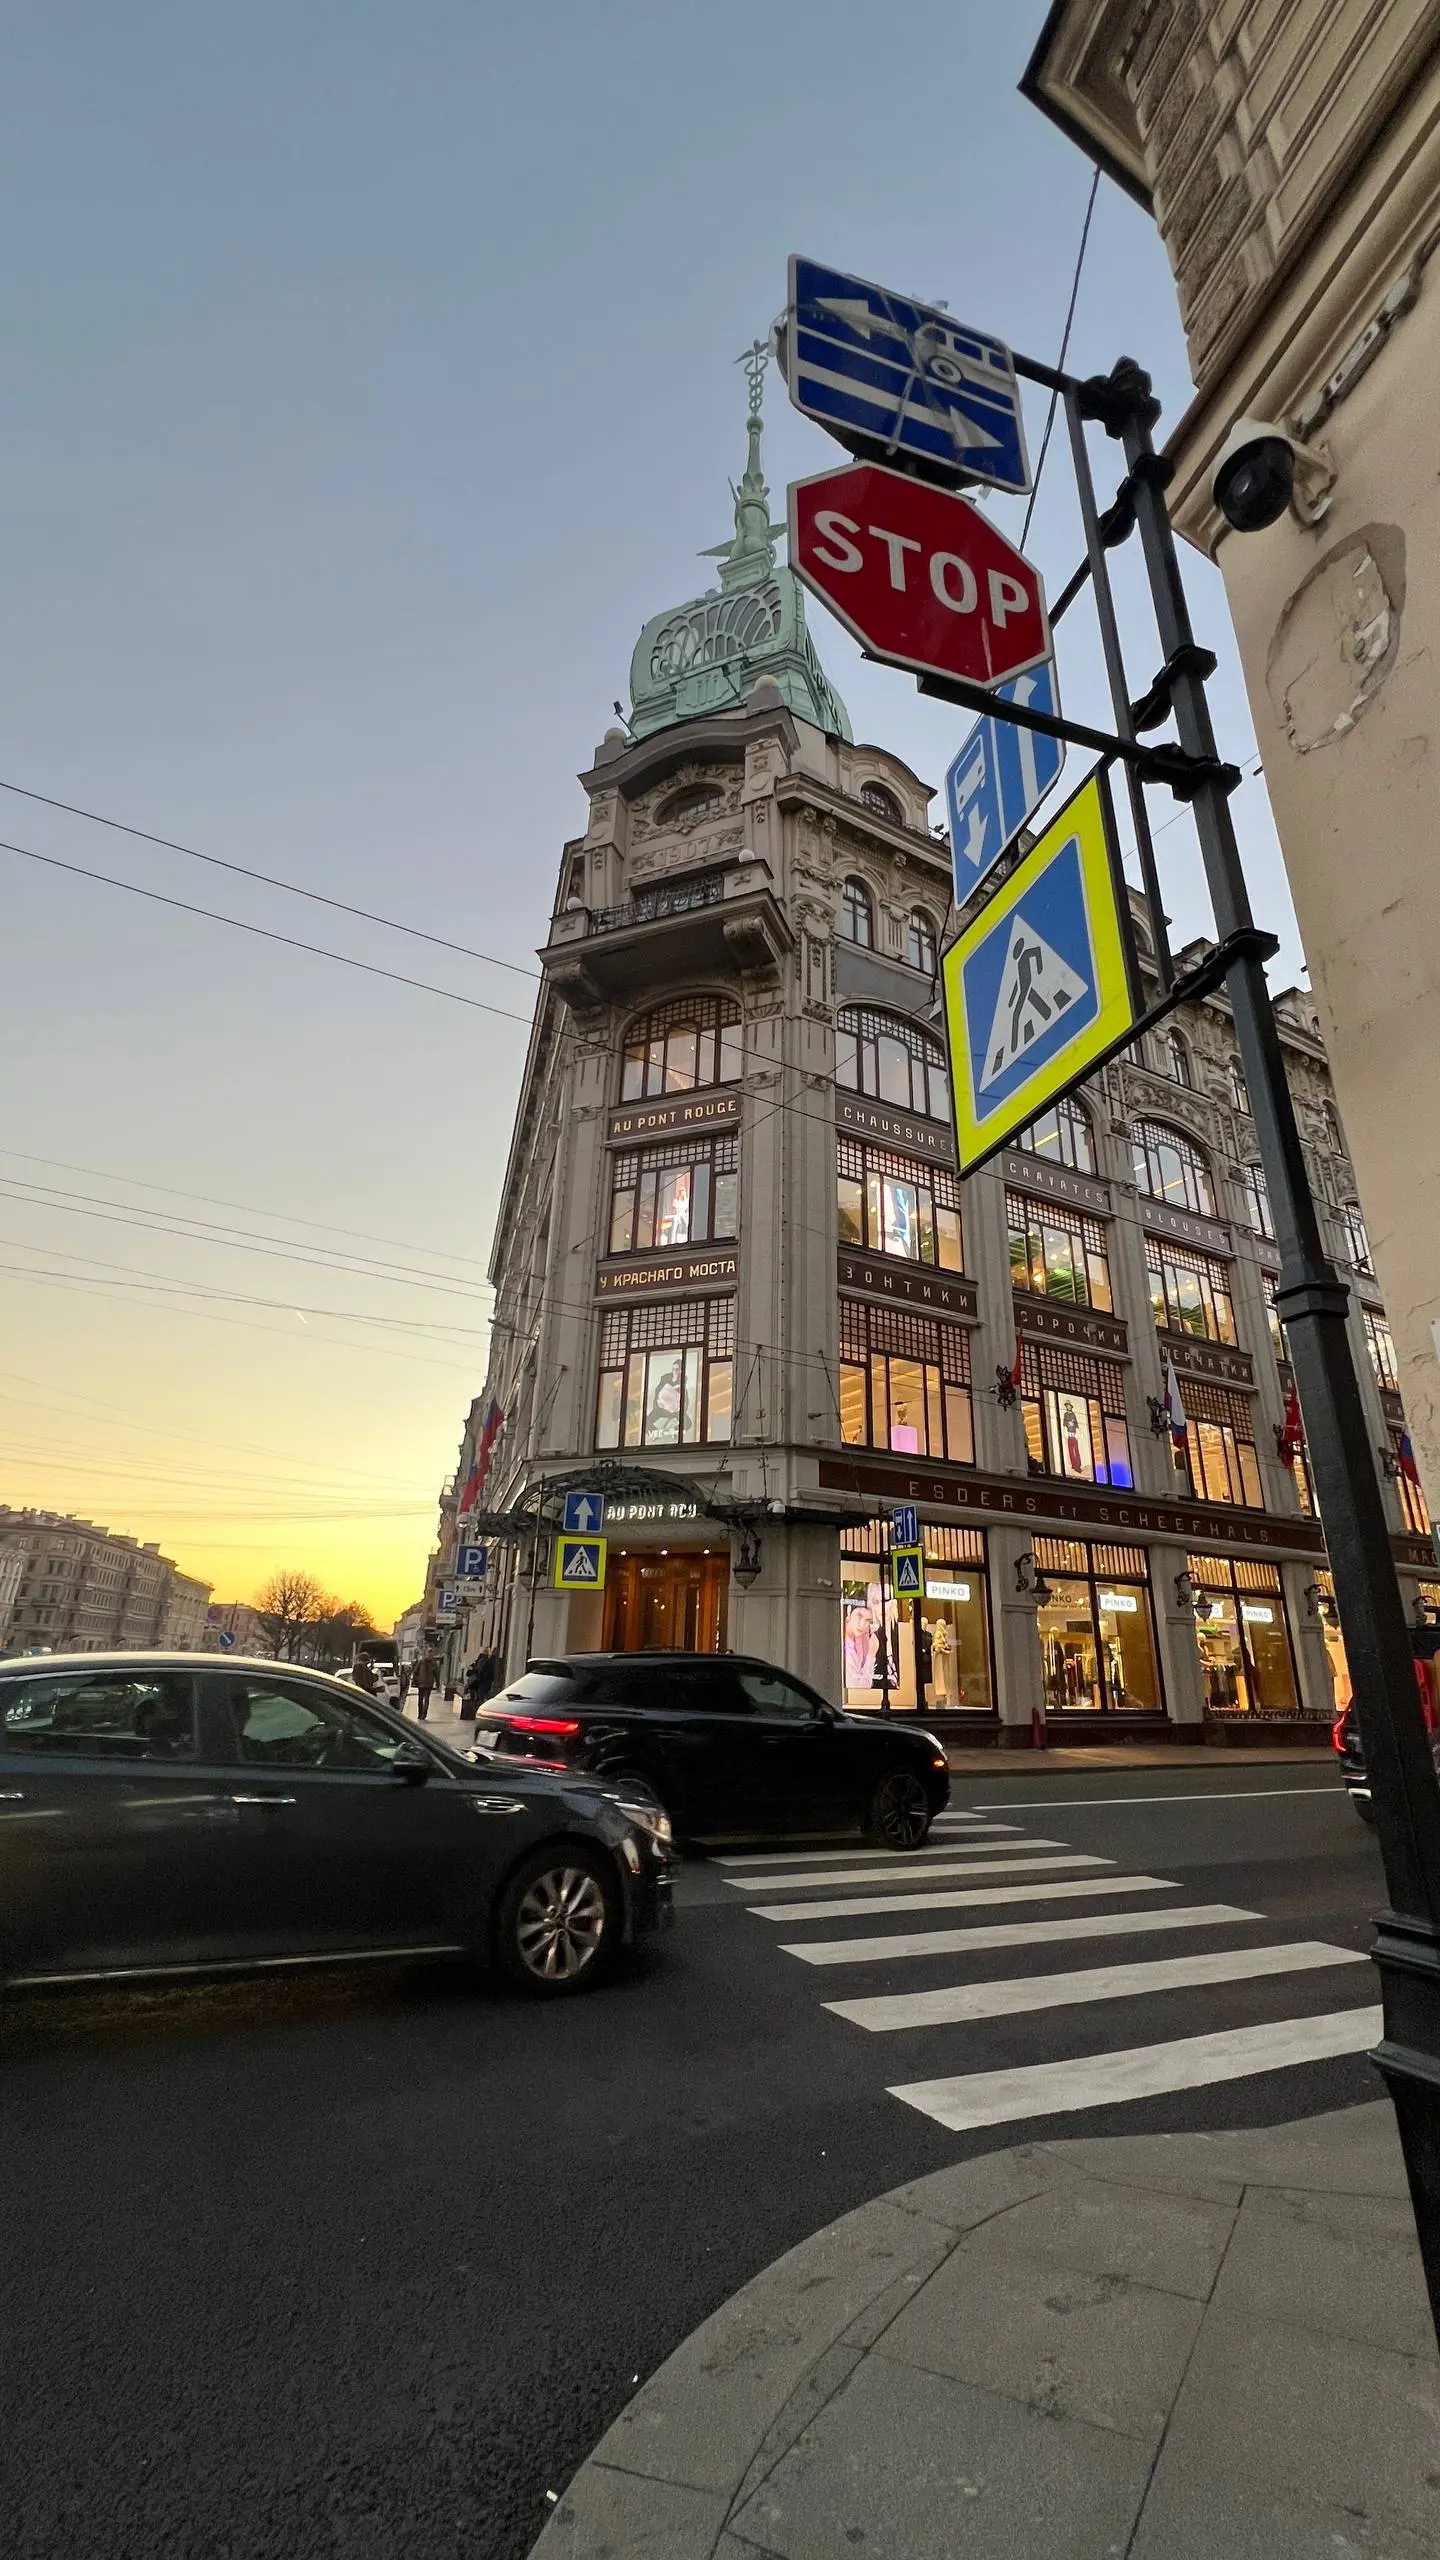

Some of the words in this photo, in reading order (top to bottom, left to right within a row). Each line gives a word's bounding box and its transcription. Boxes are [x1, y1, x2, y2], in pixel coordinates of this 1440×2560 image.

[811, 510, 1030, 629] STOP
[613, 1120, 632, 1133] AU
[638, 1111, 677, 1129] PONT
[684, 1100, 737, 1120] ROUGE
[1009, 1162, 1103, 1203] CRAVATES
[1145, 1209, 1226, 1244] BLOUSES
[600, 1276, 608, 1289] У
[613, 1267, 683, 1287] КРАСНАГО
[689, 1260, 736, 1278] МОСТА
[846, 1266, 968, 1307] ЗОНТИКИ
[1020, 1310, 1120, 1345] СОРОЧКИ
[1162, 1346, 1248, 1377] ПЕРЧАТКИ
[607, 1505, 625, 1520] AU
[629, 1504, 664, 1520] PONT
[909, 1481, 1036, 1512] ESDERS
[1099, 1507, 1269, 1543] SCHEEFHALS
[464, 1548, 482, 1573] P
[932, 1585, 965, 1597] PINKO
[1105, 1599, 1133, 1608] PINKO
